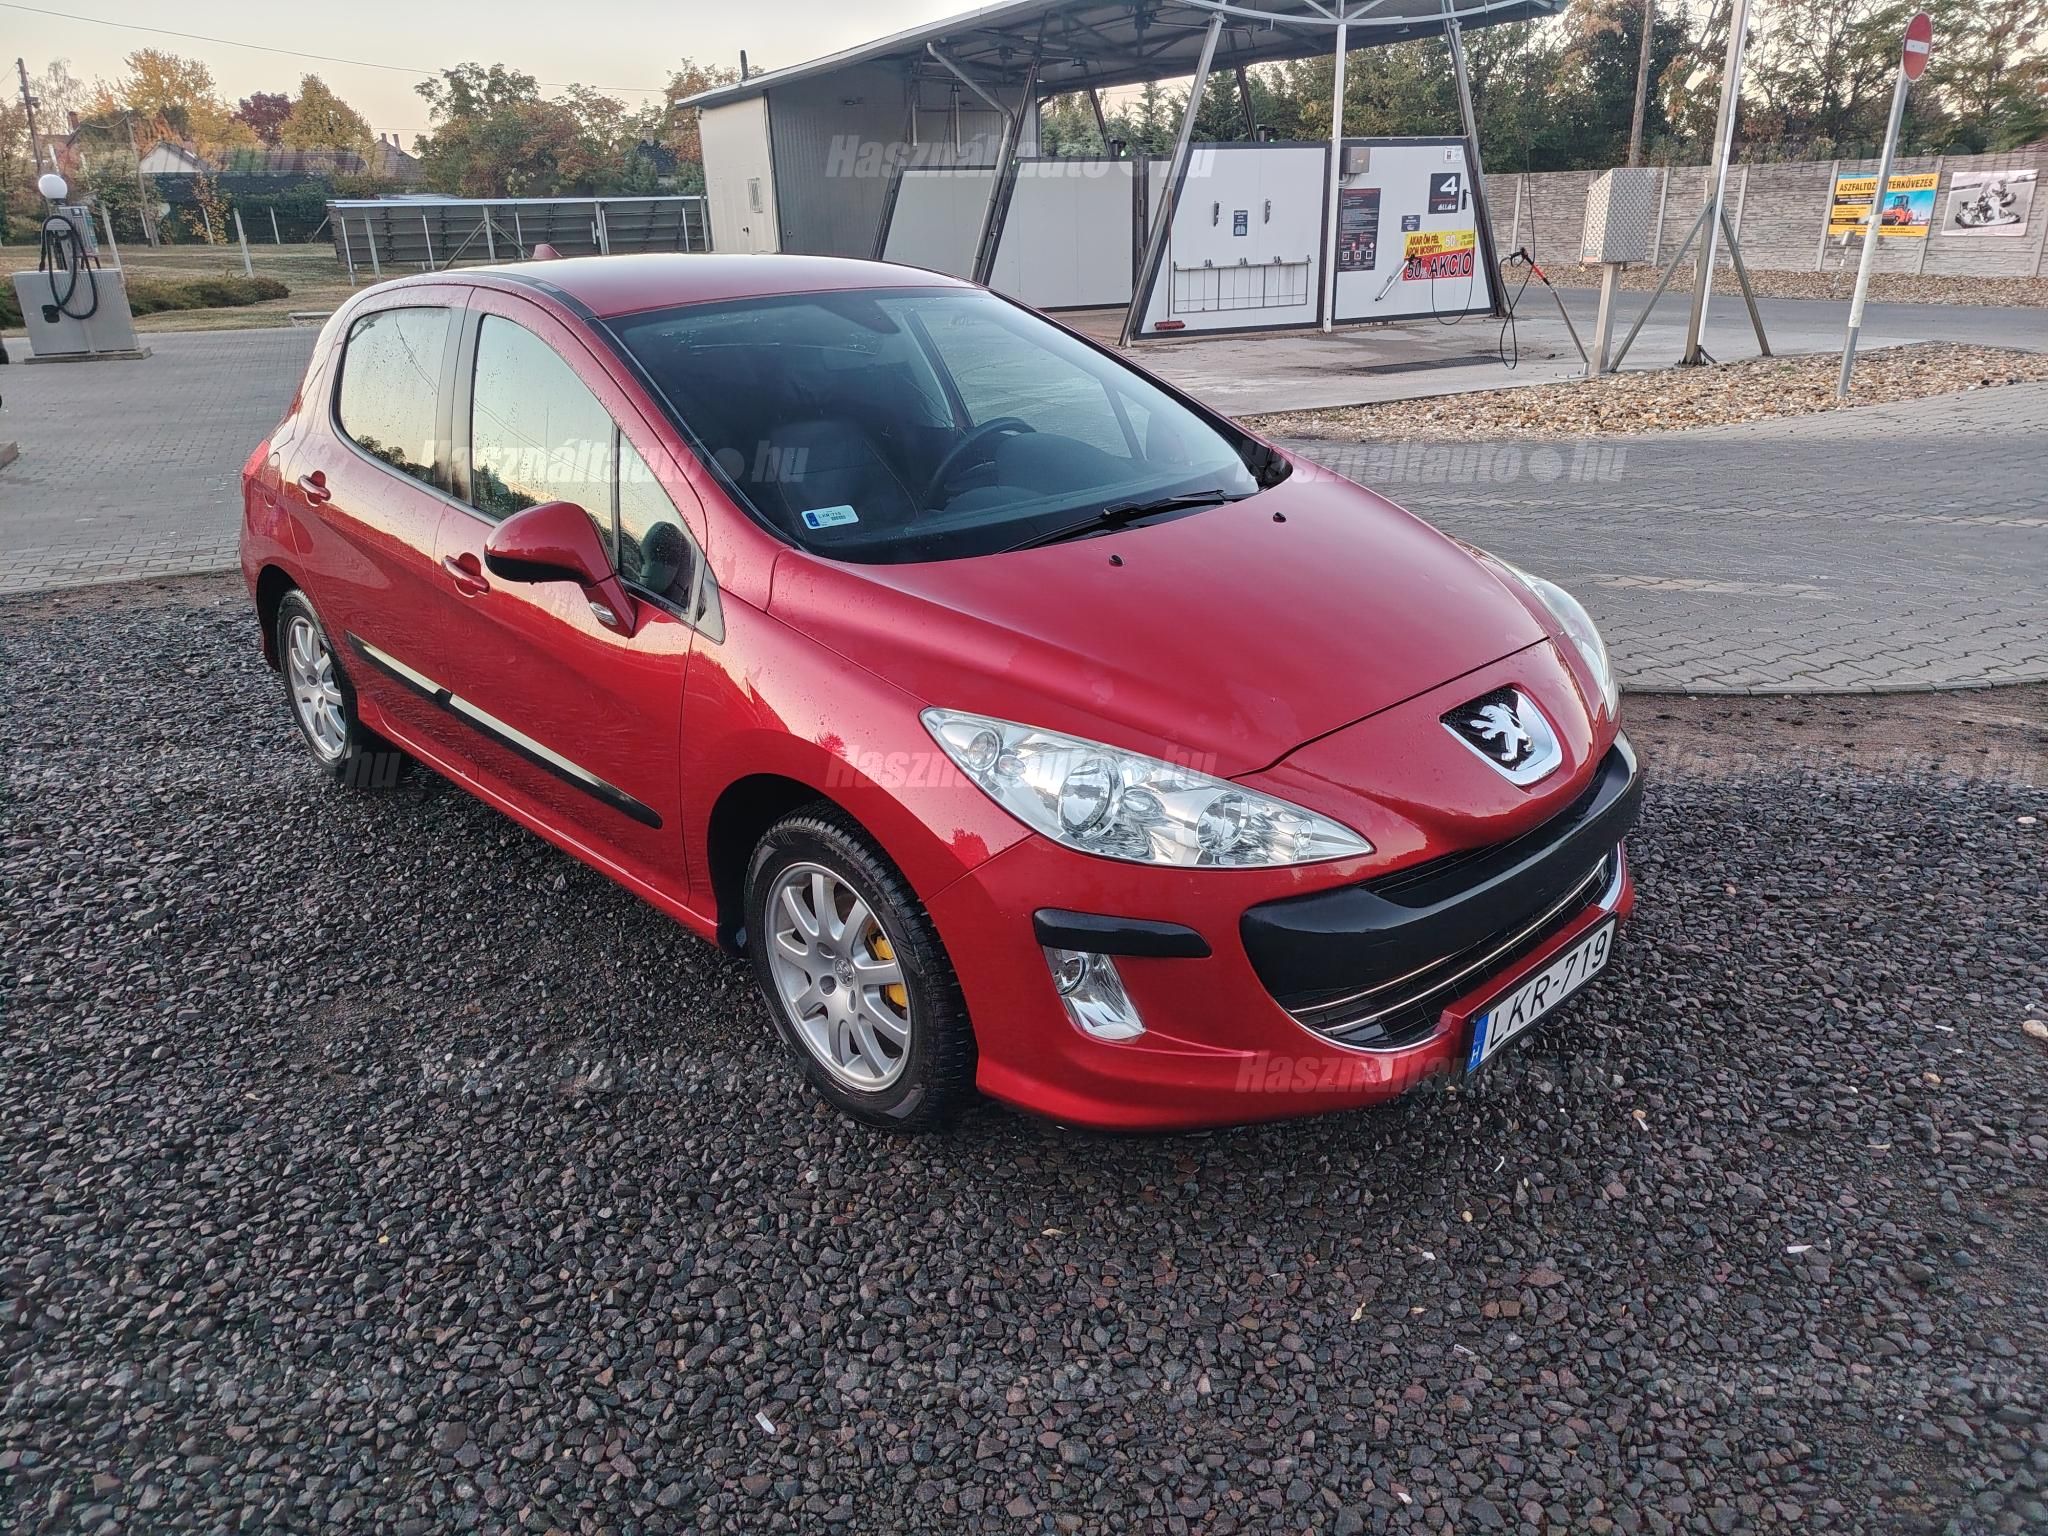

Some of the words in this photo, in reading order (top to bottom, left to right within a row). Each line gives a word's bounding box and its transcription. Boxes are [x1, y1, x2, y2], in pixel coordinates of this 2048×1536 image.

[1440, 175, 1458, 196] 4
[1839, 182, 1878, 192] ASZFALTOZ
[1429, 251, 1472, 277] AKCIÓ
[1489, 930, 1608, 1050] LKR-719
[1470, 1045, 1481, 1063] H
